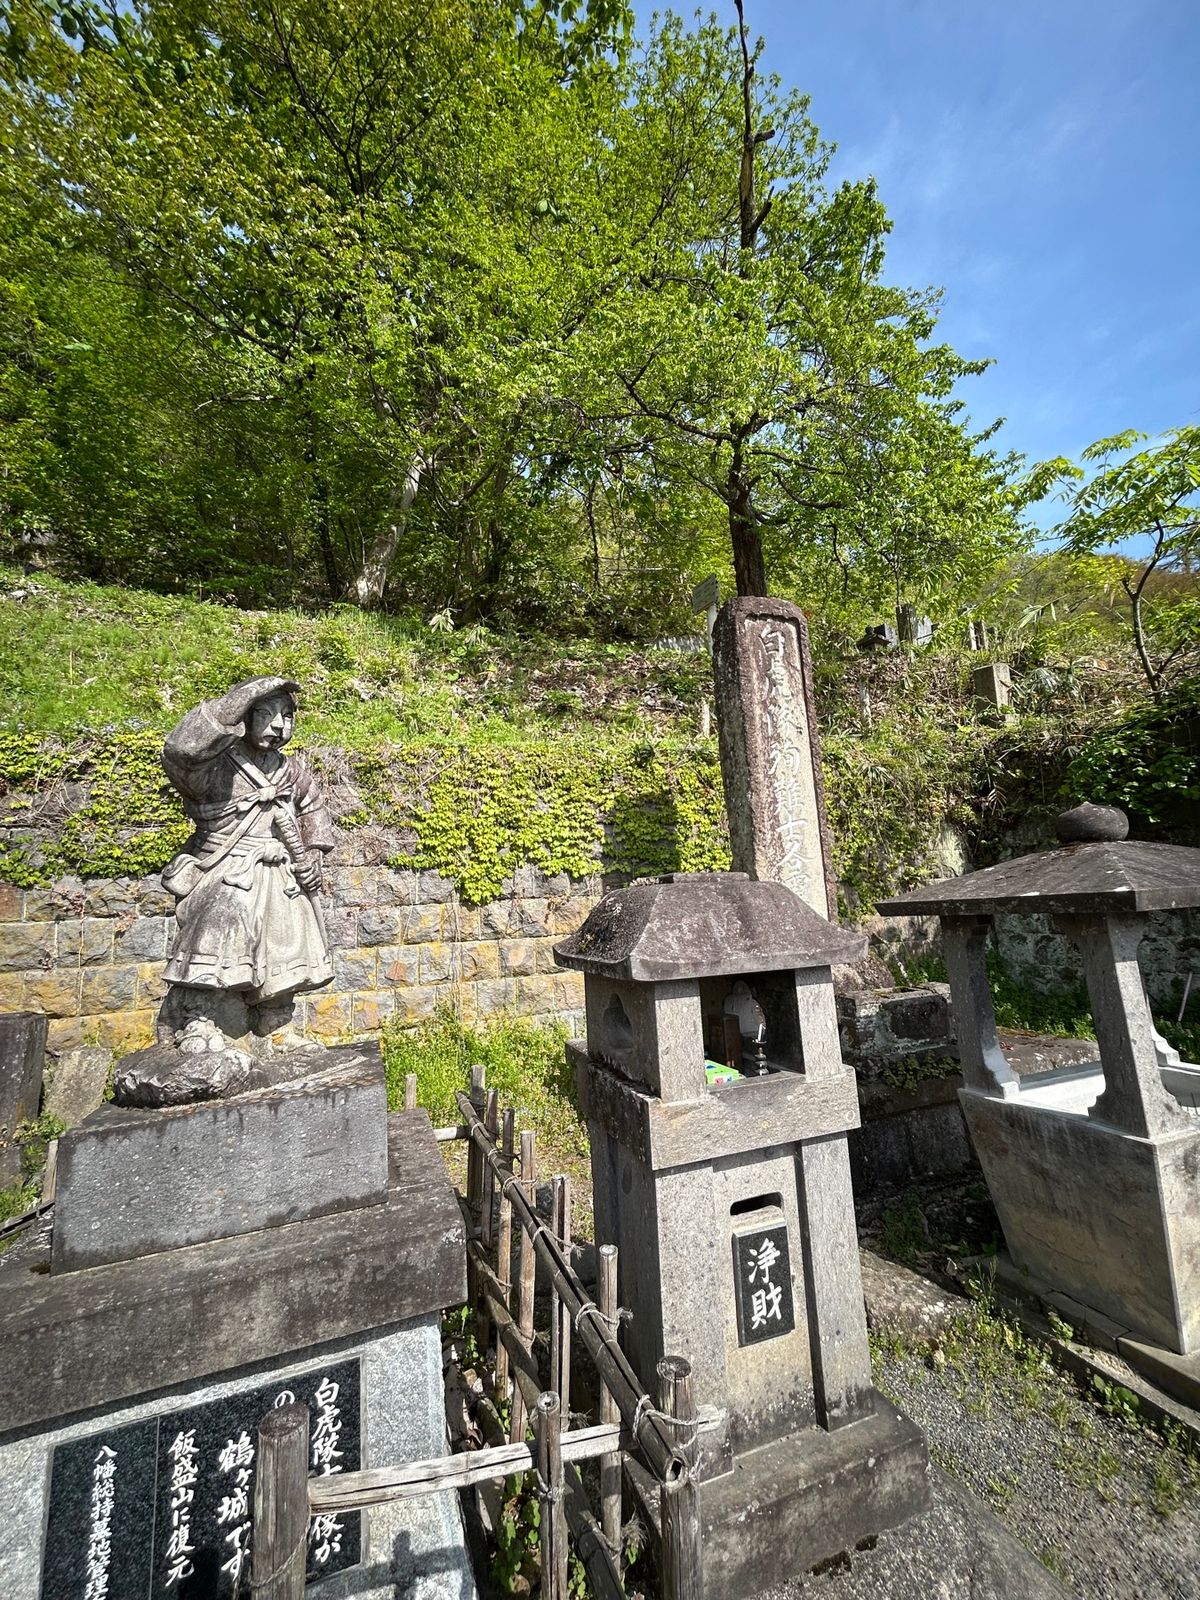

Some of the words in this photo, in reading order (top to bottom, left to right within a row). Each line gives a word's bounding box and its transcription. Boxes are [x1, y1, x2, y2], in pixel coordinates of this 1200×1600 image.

[747, 1237, 783, 1330] 浄財
[83, 1445, 118, 1600] 八幡総持墓地管理
[165, 1429, 200, 1587] 飯盛山に復元
[312, 1377, 345, 1563] 白虎隊像が
